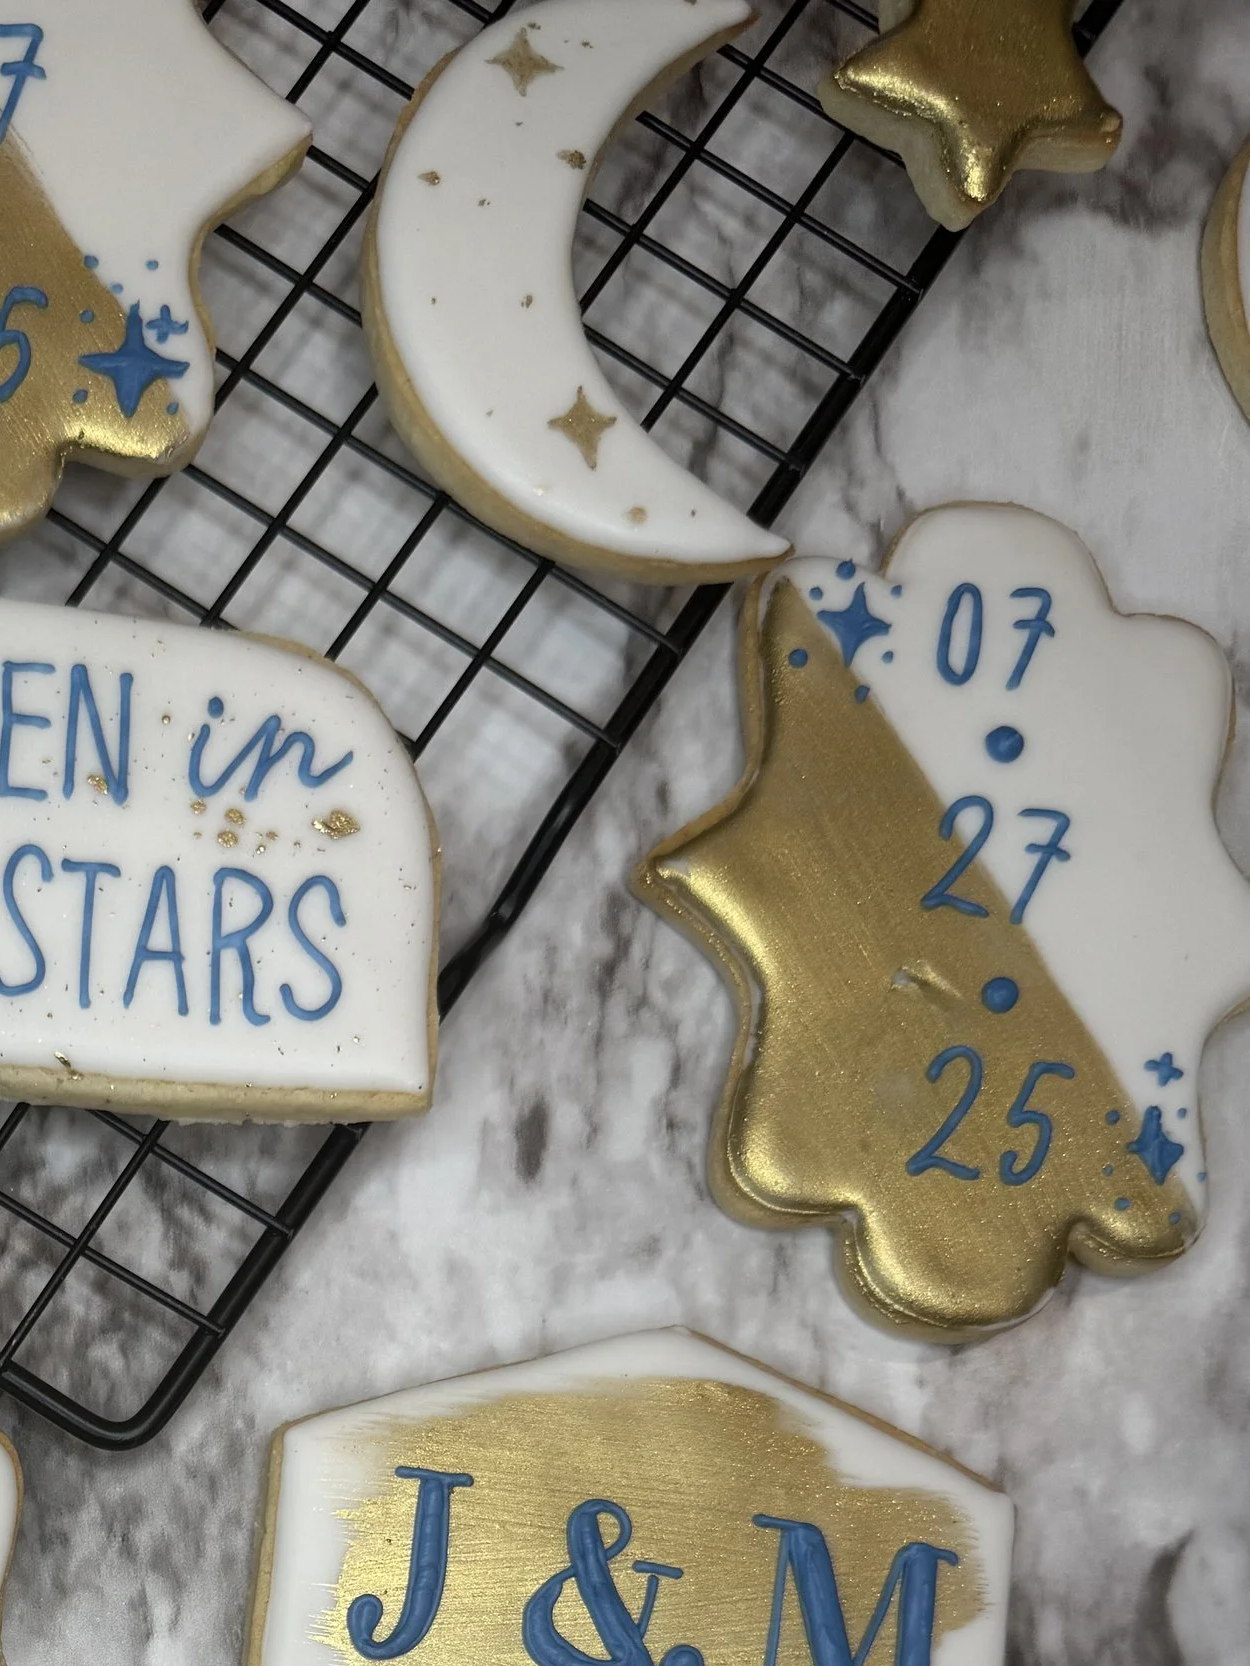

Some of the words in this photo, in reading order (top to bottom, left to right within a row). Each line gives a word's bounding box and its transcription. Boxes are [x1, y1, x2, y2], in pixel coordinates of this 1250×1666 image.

[934, 582, 1058, 690] 07
[187, 696, 353, 802] in
[920, 794, 1075, 924] 27
[907, 1046, 1074, 1184] 25
[347, 1466, 472, 1661] J
